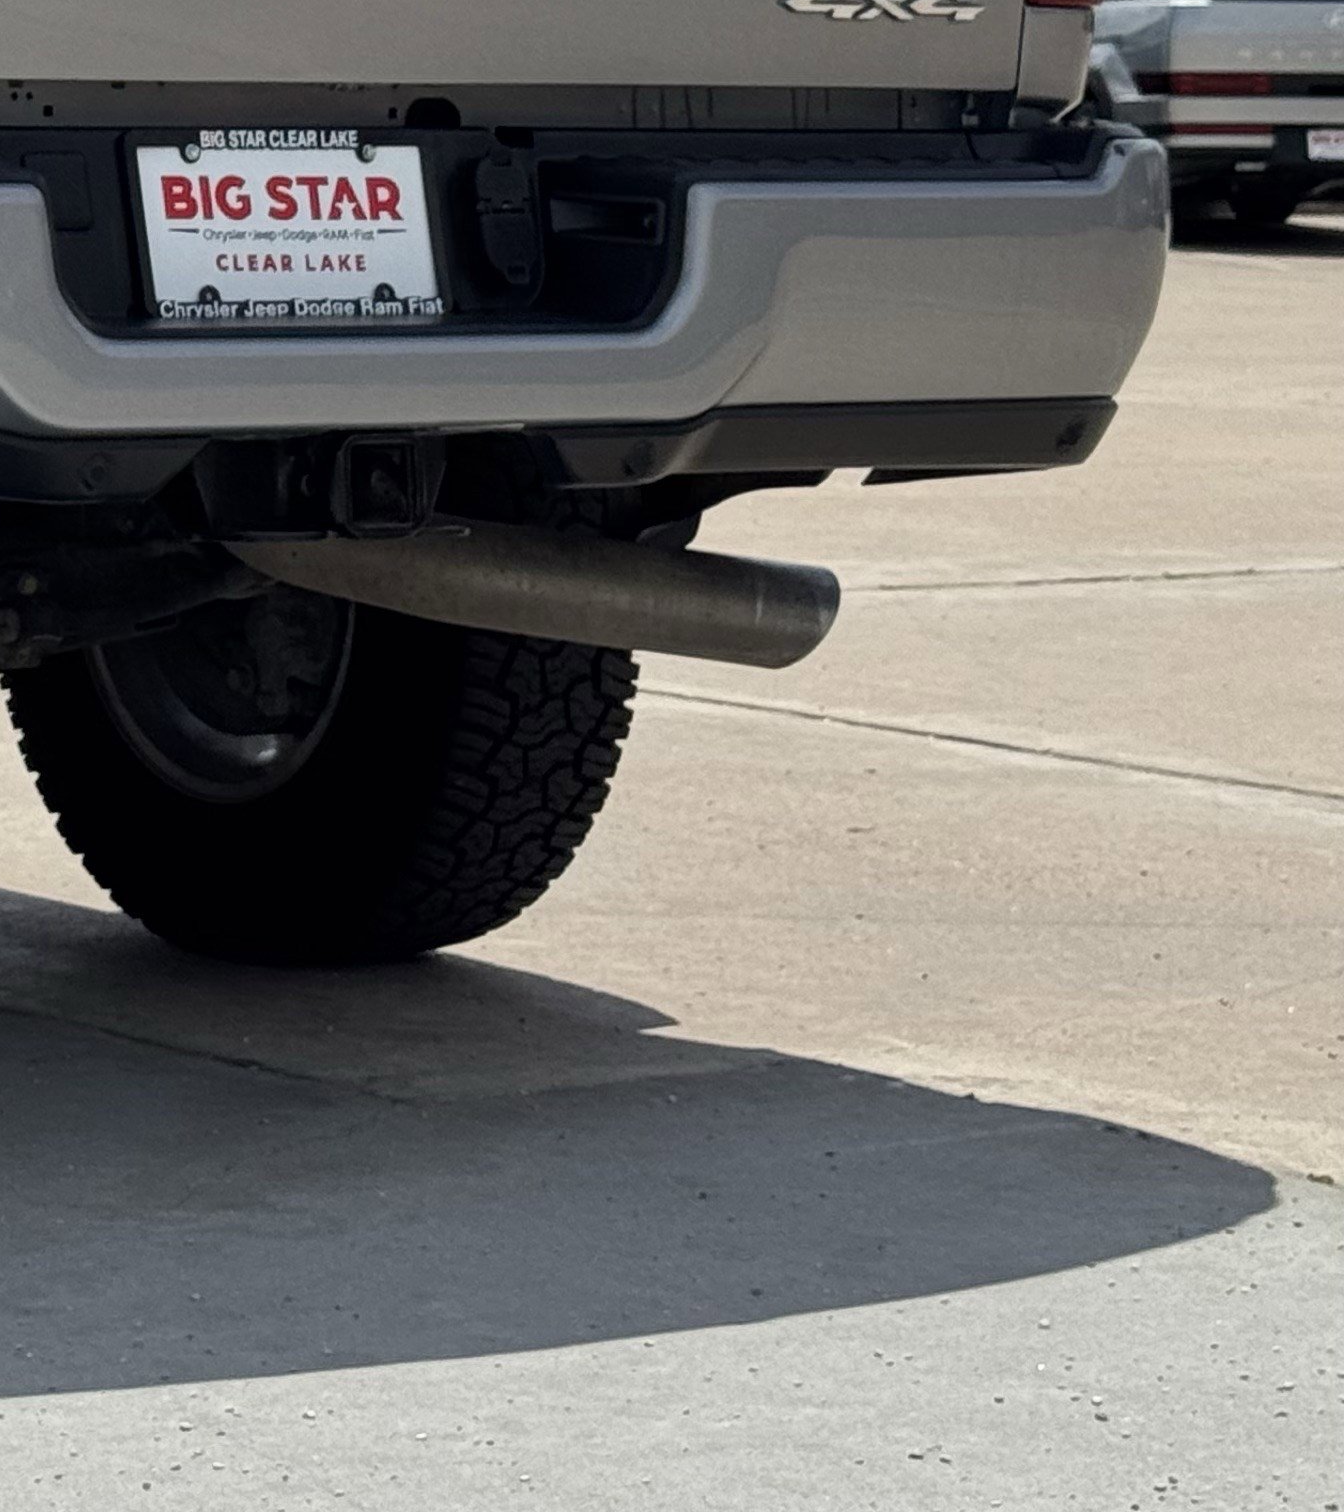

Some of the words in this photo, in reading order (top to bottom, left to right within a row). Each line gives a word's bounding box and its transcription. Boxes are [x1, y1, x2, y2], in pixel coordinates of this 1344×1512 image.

[199, 130, 225, 148] BIG
[228, 130, 266, 147] STAR
[269, 130, 318, 147] CLEAR
[320, 130, 359, 147] LAKE
[160, 175, 252, 220] BIG
[266, 176, 404, 220] STAR
[216, 254, 293, 272] CLEAR
[305, 254, 367, 272] LAKE
[160, 300, 238, 319] Chrysler
[244, 300, 289, 318] Jeep
[294, 299, 355, 317] Dodge
[360, 299, 403, 316] Ram
[408, 298, 445, 315] Fiat
